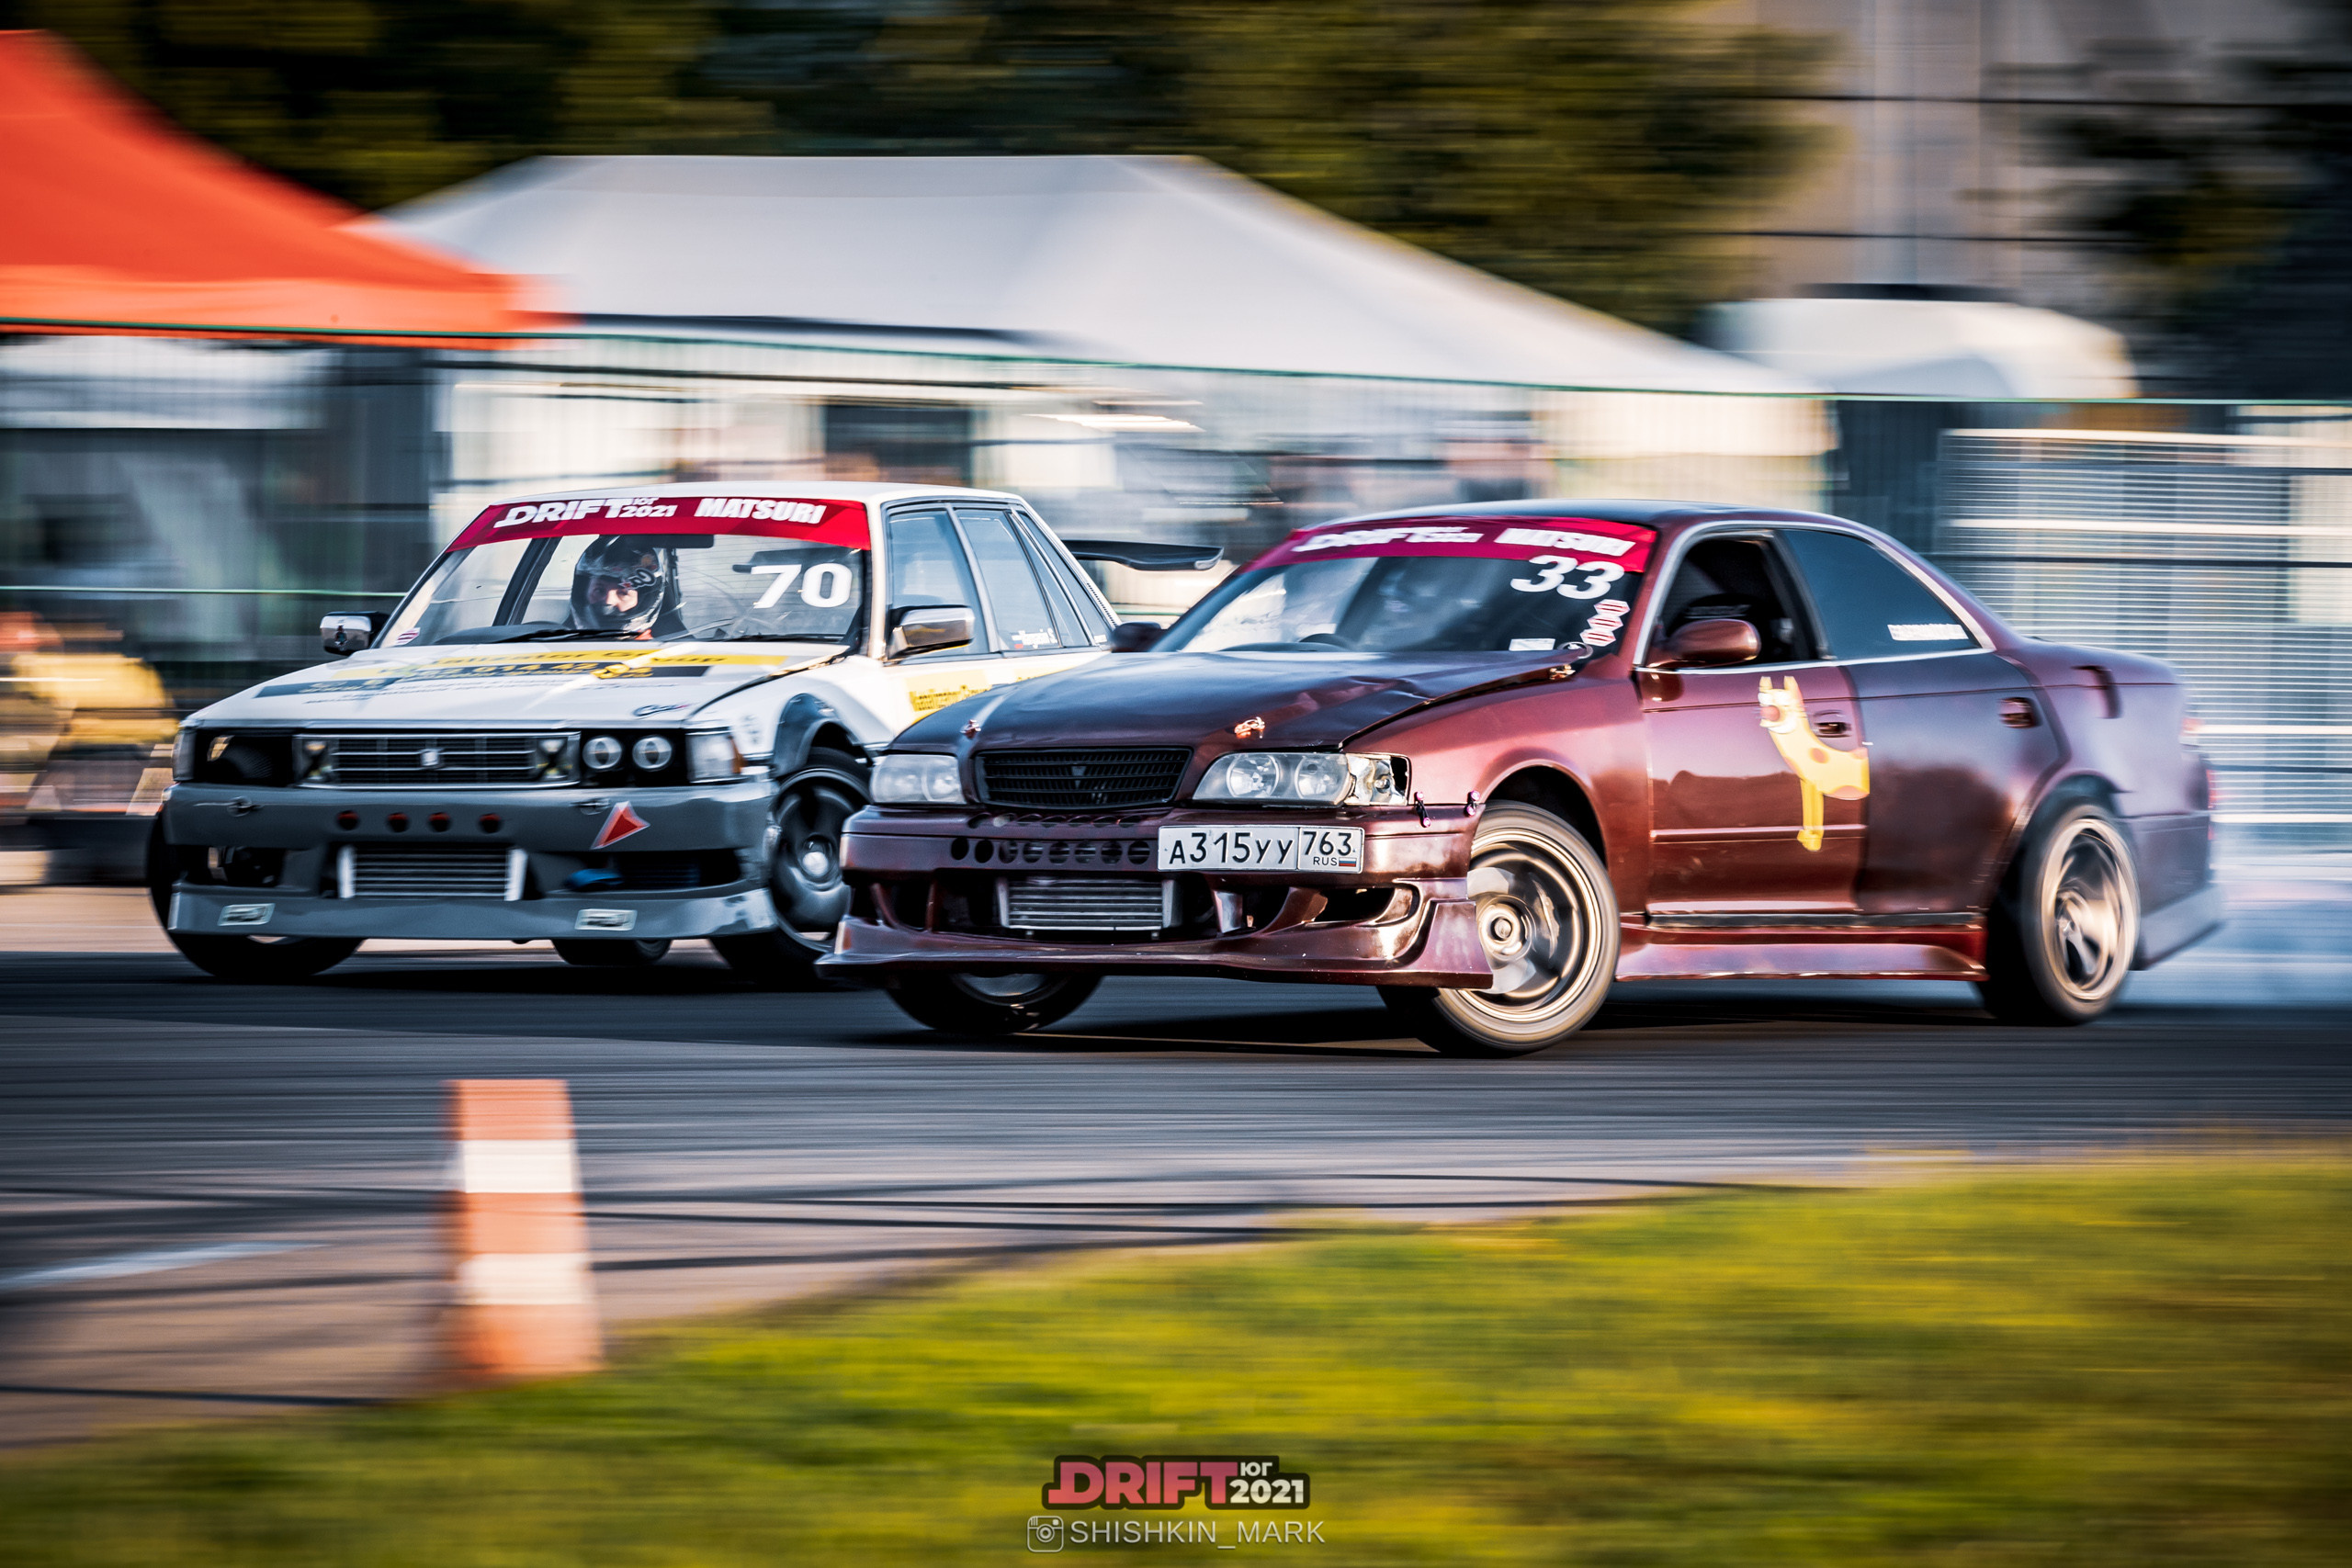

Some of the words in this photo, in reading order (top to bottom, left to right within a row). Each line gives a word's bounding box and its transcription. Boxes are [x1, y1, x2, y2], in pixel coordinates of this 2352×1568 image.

[493, 499, 634, 528] DRIFT
[618, 504, 678, 518] 2021
[694, 498, 827, 525] MATSURI
[750, 562, 853, 609] 70
[1510, 554, 1625, 600] 33
[1303, 831, 1352, 856] 763
[1313, 857, 1338, 866] RUS
